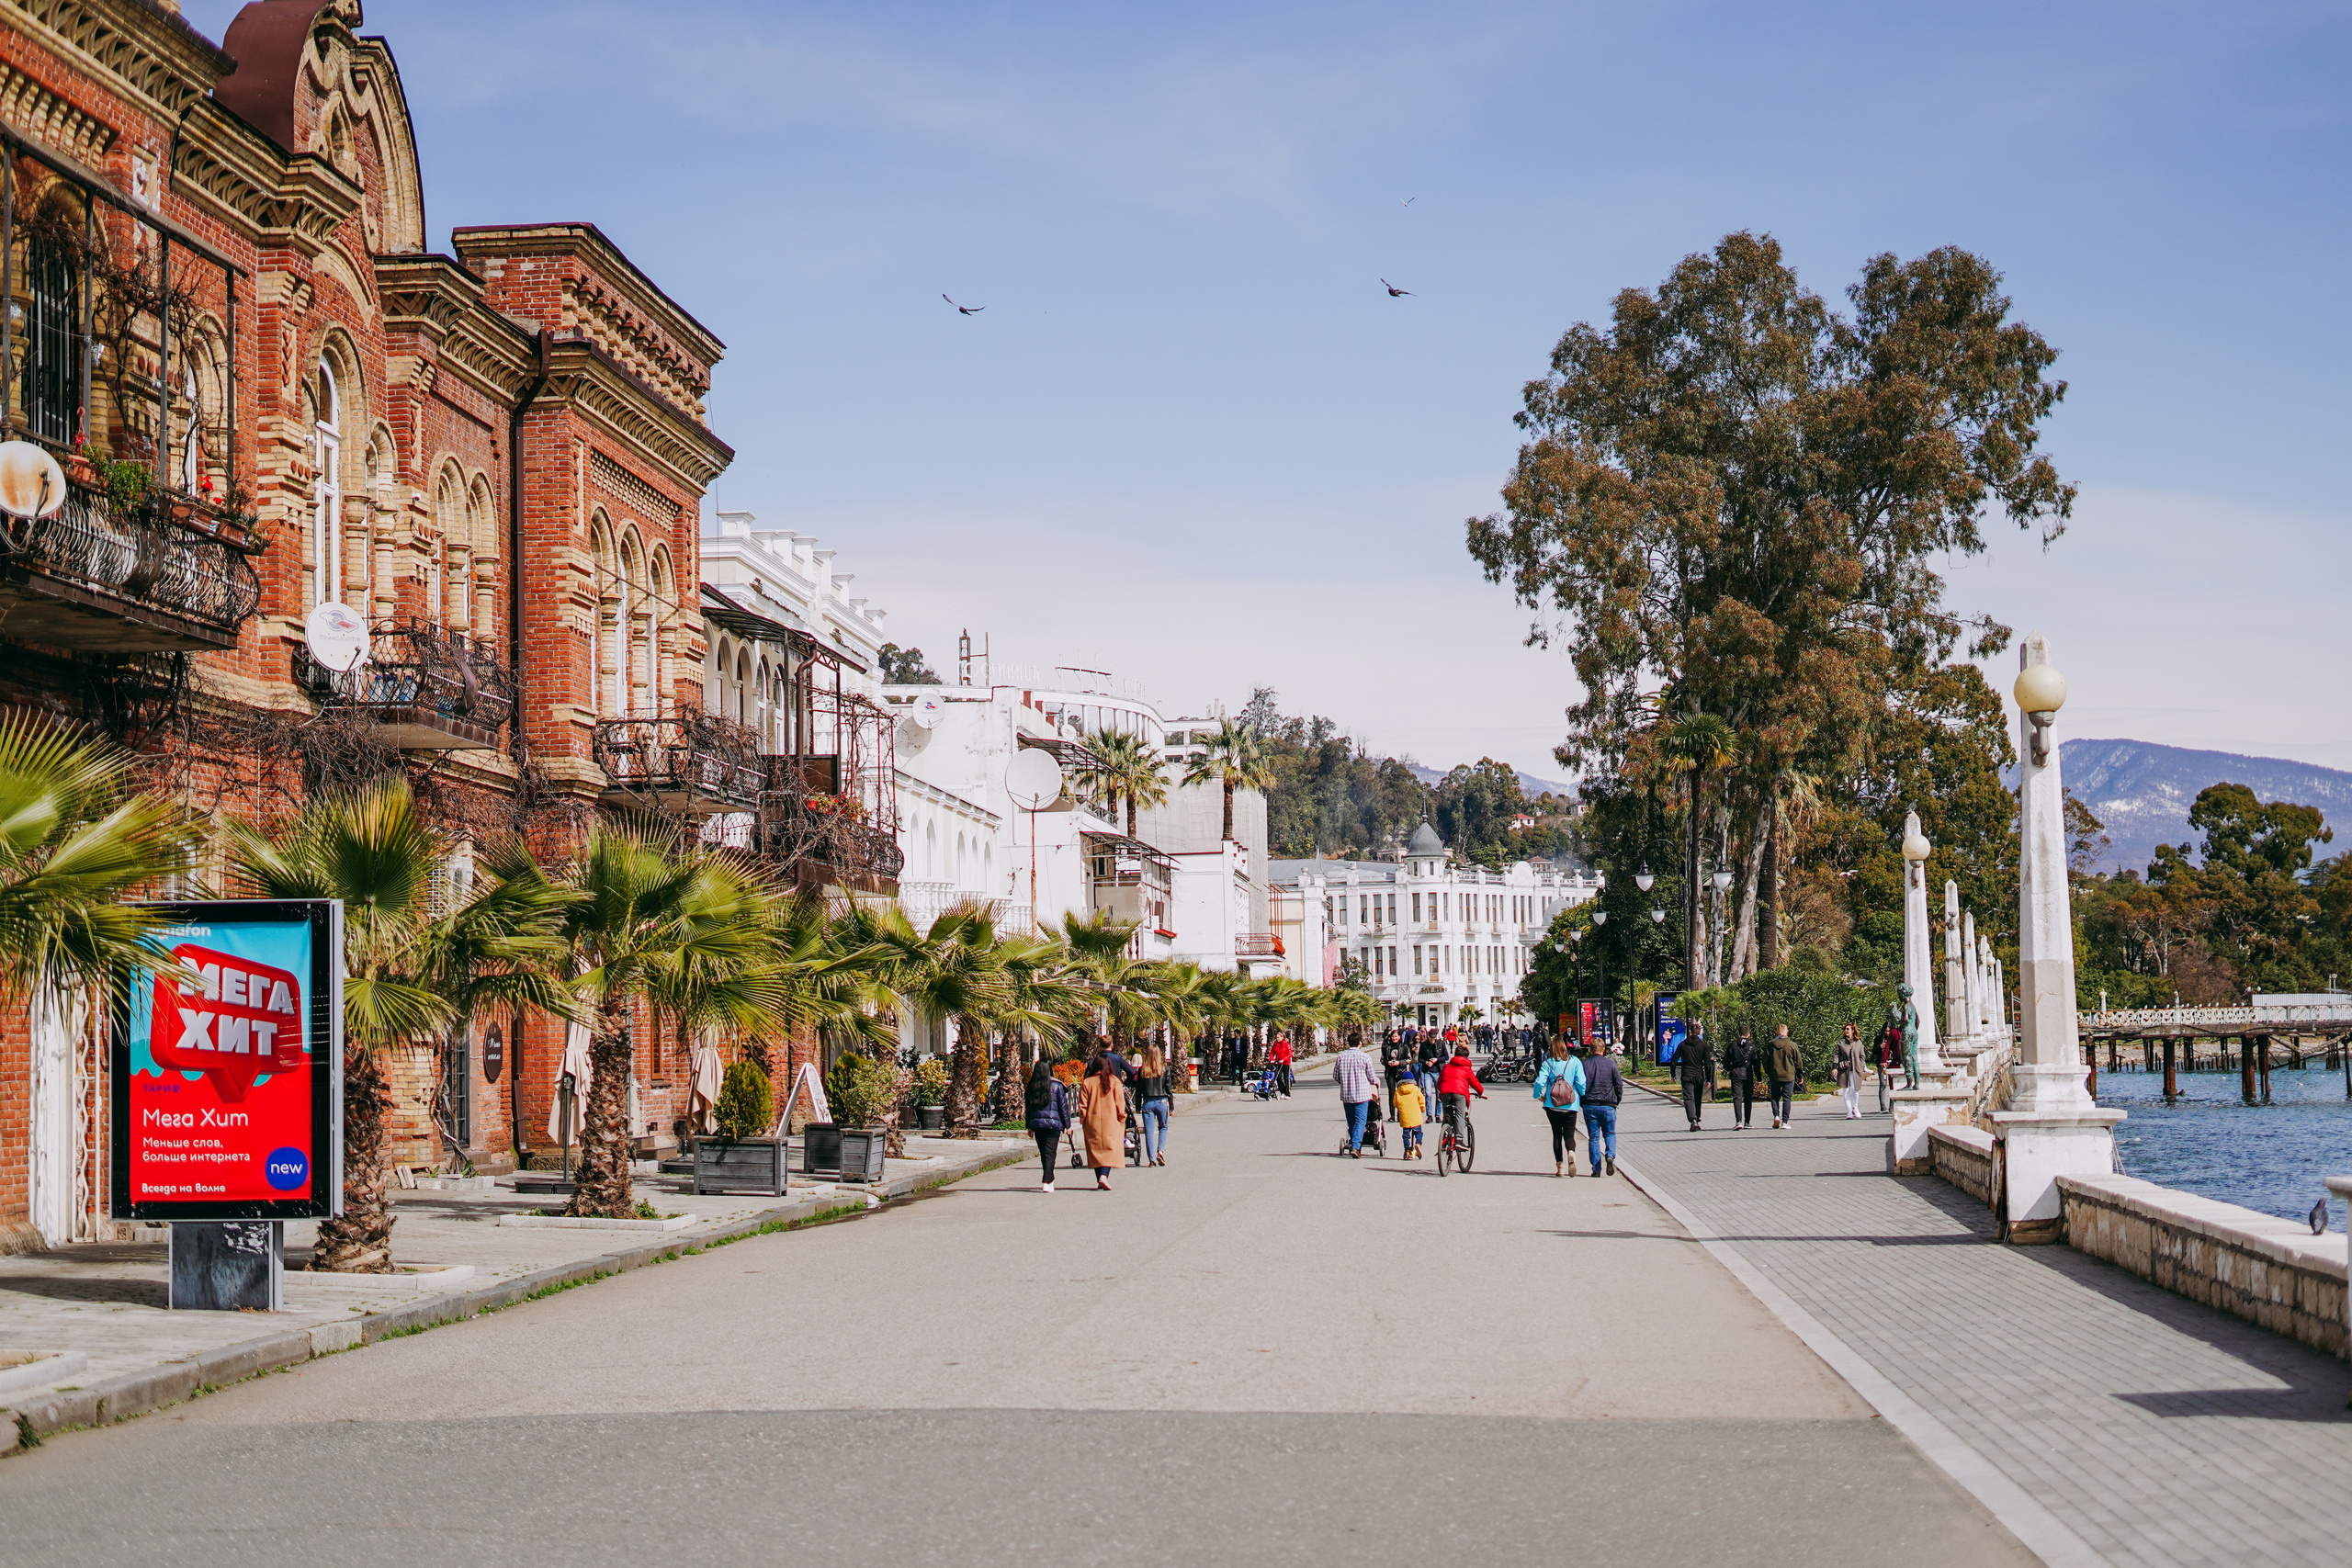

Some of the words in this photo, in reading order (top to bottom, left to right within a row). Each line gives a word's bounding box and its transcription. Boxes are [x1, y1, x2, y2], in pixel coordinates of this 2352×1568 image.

[957, 661, 1041, 684] ГОСТИНИЦА
[177, 955, 295, 1015] МЕГА
[175, 1007, 277, 1056] ХИТ
[142, 1084, 181, 1093] ТАРИФ
[142, 1108, 194, 1127] Мега
[199, 1108, 249, 1127] Хит
[142, 1136, 190, 1148] Меньше
[192, 1139, 223, 1148] слов,
[142, 1150, 187, 1163] больше
[190, 1153, 251, 1165] интернета
[270, 1162, 303, 1175] new
[141, 1182, 177, 1195] Всегда
[179, 1185, 193, 1193] на
[195, 1182, 226, 1193] волне
